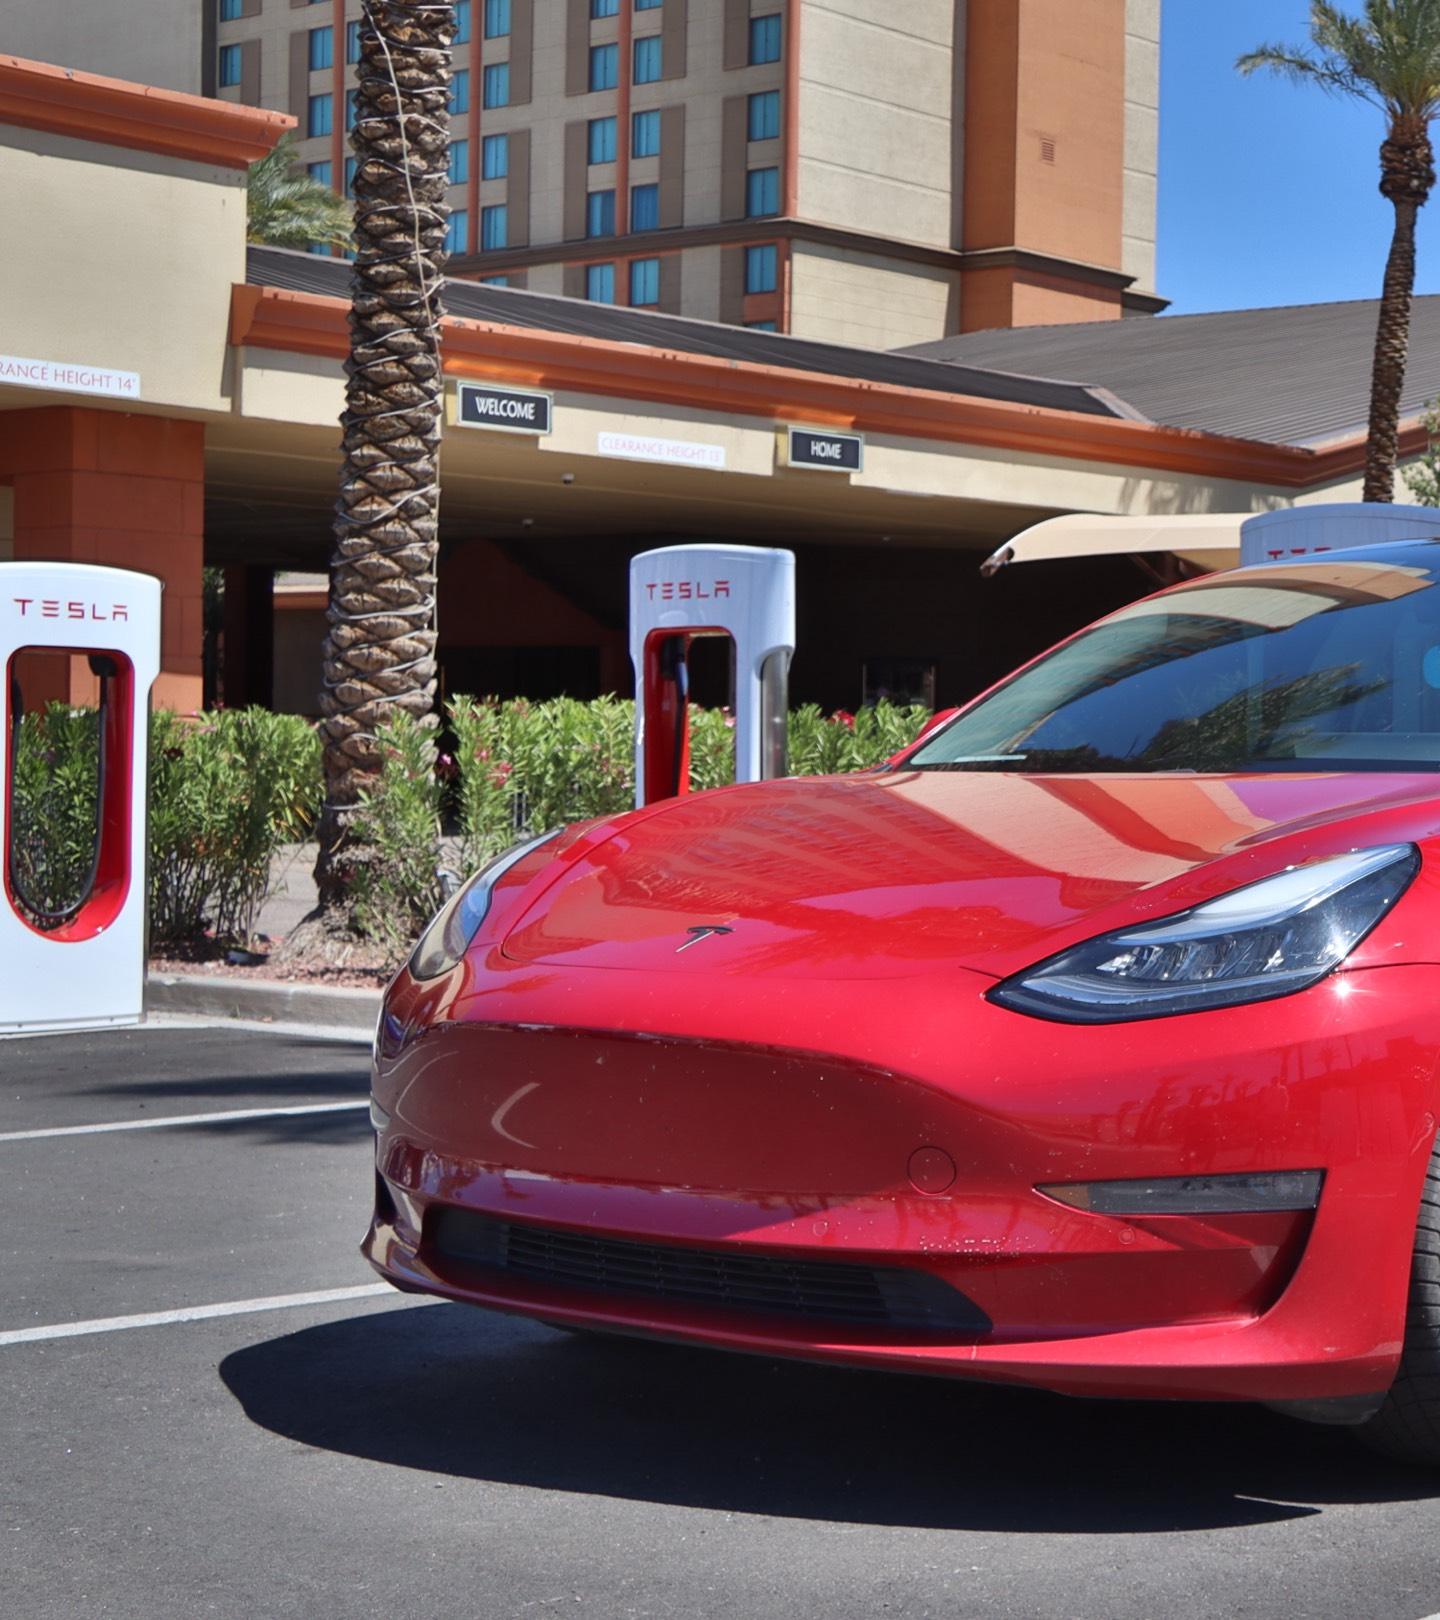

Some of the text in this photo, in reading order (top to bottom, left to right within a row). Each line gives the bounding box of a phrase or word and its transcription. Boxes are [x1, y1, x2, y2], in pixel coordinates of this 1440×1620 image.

[54, 368, 112, 388] HEIGHT
[475, 396, 536, 420] WELCOME
[601, 437, 663, 456] CLEARANCE
[666, 446, 706, 462] HEIGHT
[810, 440, 842, 459] HOME
[646, 580, 730, 600] TESLA
[13, 598, 128, 622] TESLA
